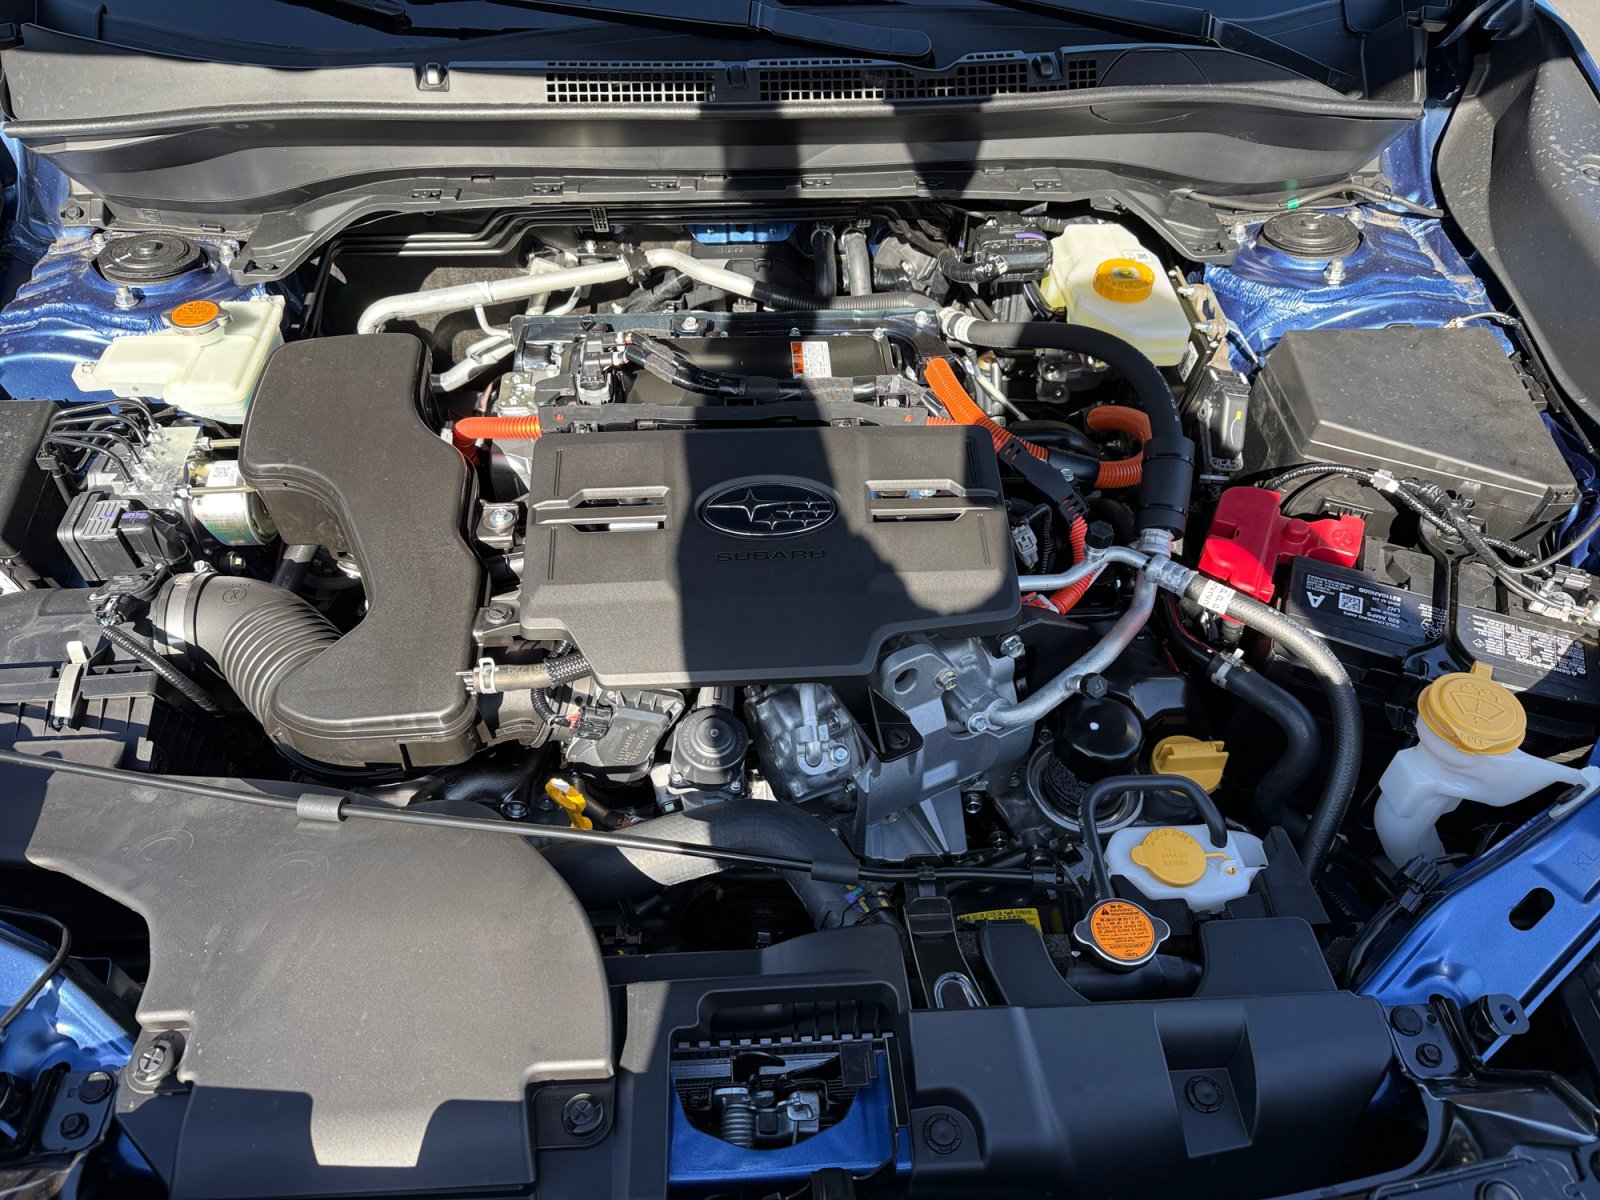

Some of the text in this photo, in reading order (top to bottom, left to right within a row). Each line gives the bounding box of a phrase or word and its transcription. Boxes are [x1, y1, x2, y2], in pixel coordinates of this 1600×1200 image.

[715, 549, 826, 562] SUBARU
[1358, 614, 1386, 626] CRANKING
[1366, 611, 1400, 624] 620 AMPS
[1385, 621, 1400, 629] COLD
